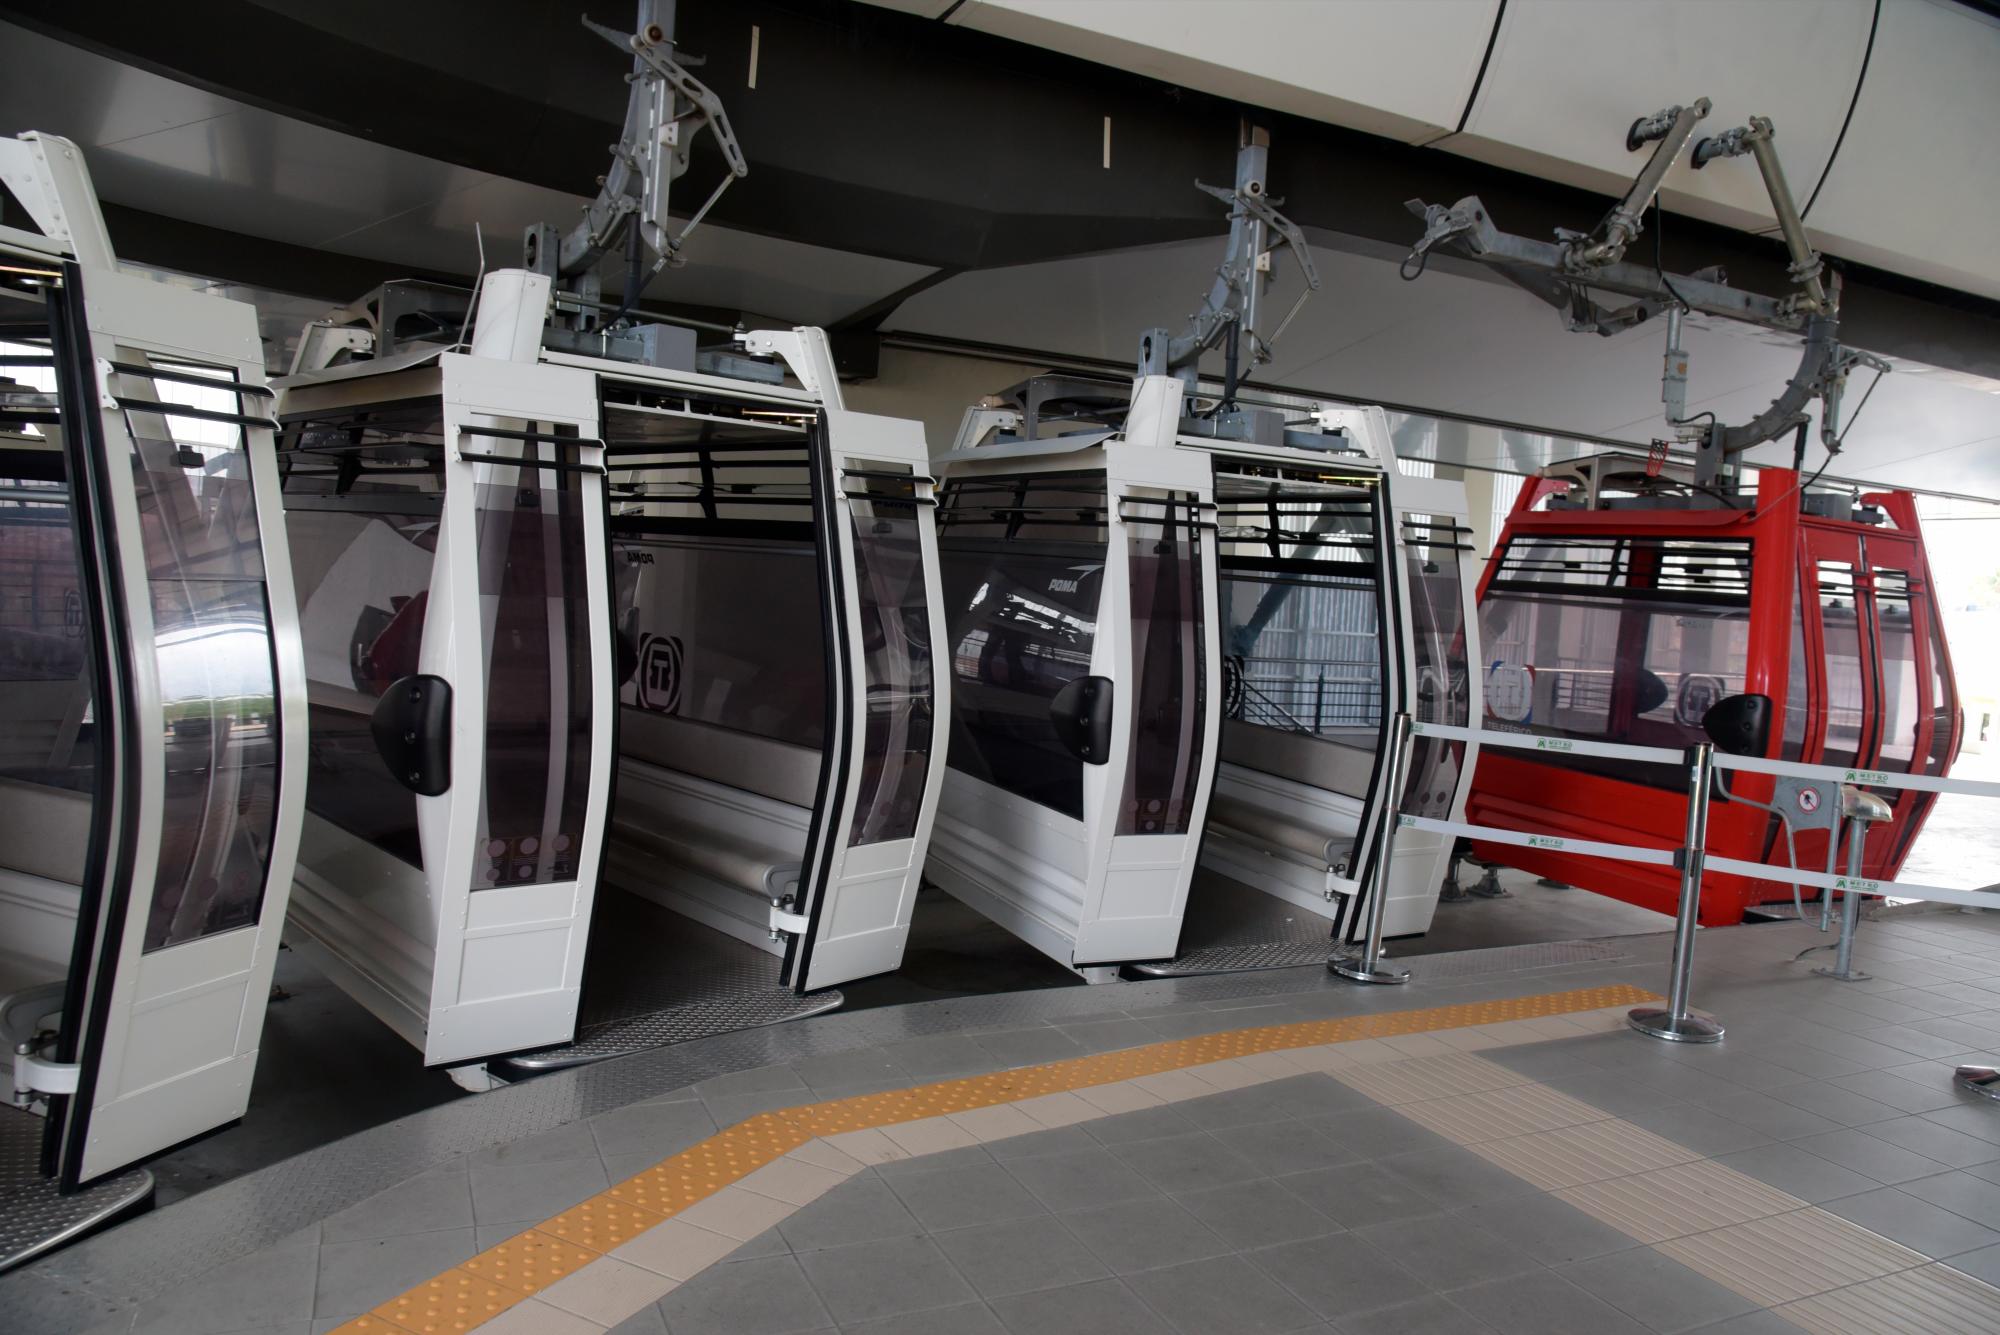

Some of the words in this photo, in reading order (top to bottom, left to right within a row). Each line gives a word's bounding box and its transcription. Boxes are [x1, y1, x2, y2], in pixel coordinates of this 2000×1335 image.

[1048, 579, 1078, 593] POMA
[1860, 772, 1888, 781] METRO
[1850, 880, 1878, 889] METRO
